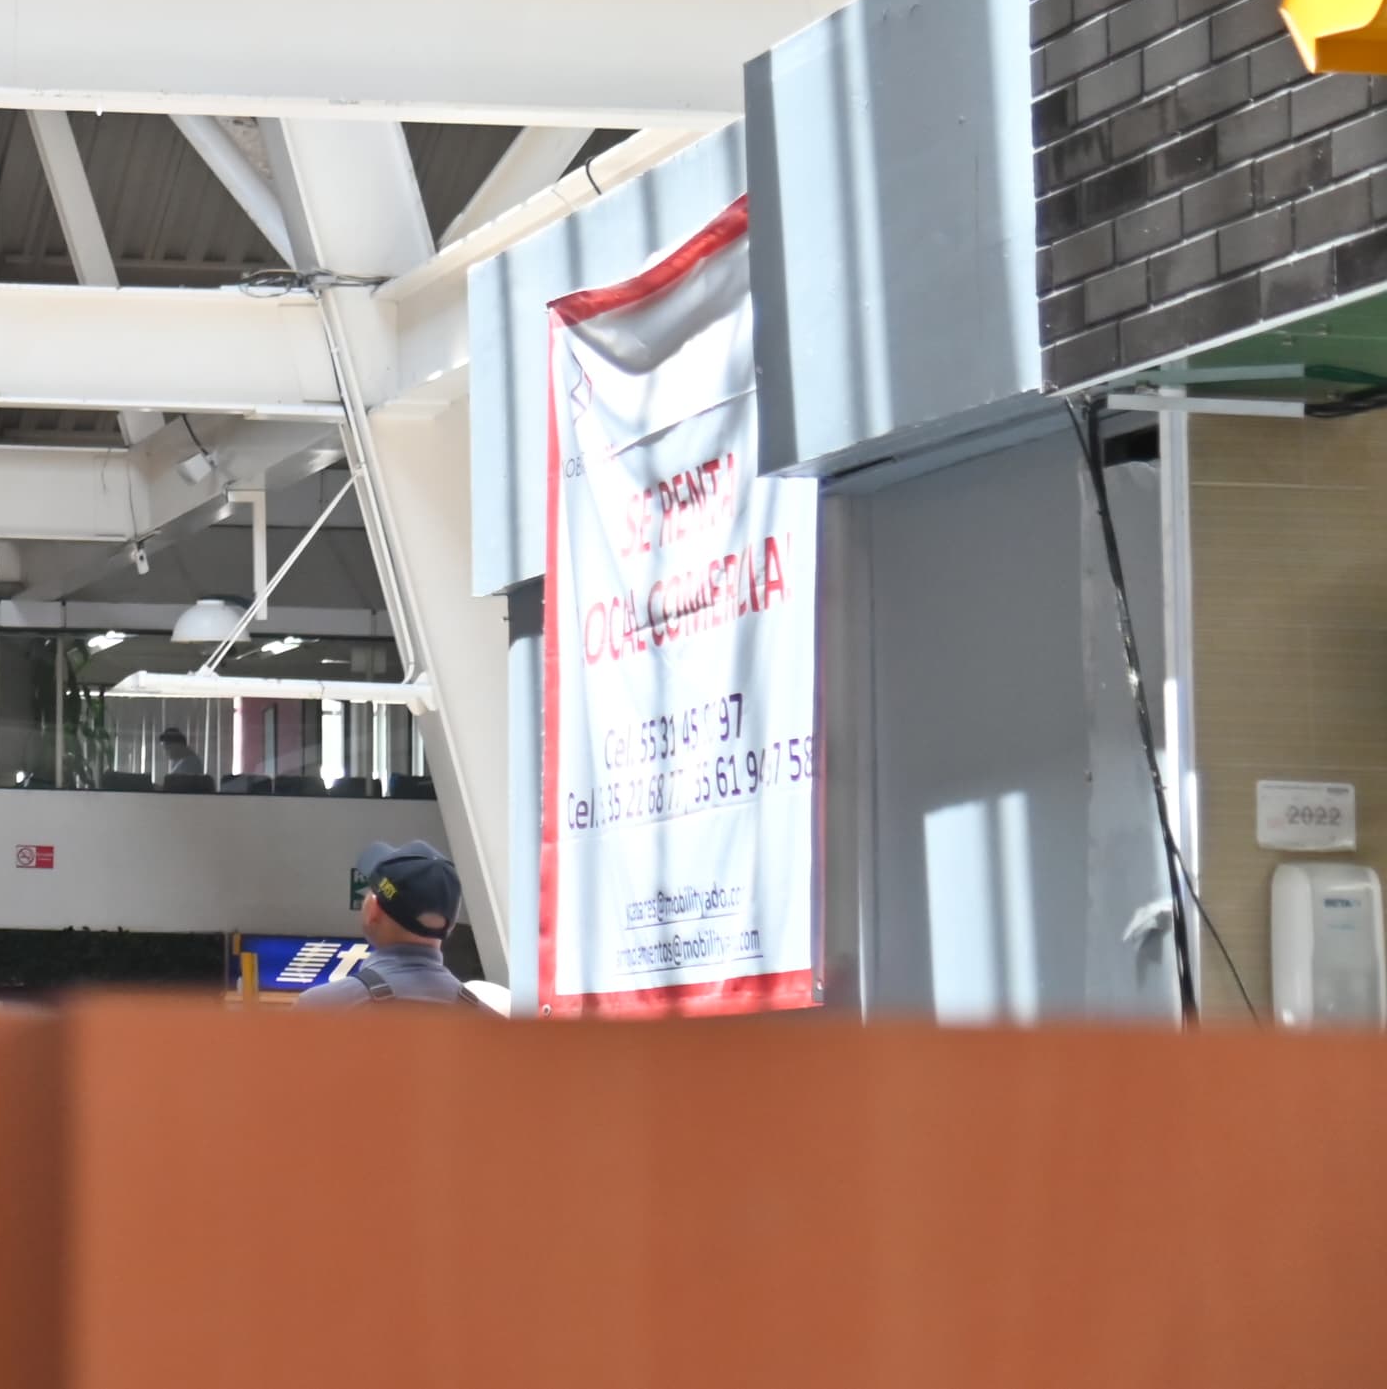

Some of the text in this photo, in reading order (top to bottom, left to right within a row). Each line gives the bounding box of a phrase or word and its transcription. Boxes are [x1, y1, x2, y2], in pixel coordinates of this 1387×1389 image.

[582, 588, 647, 665] OCAL
[718, 692, 744, 743] 97
[715, 754, 743, 799] 61
[1287, 804, 1342, 827] 2022
